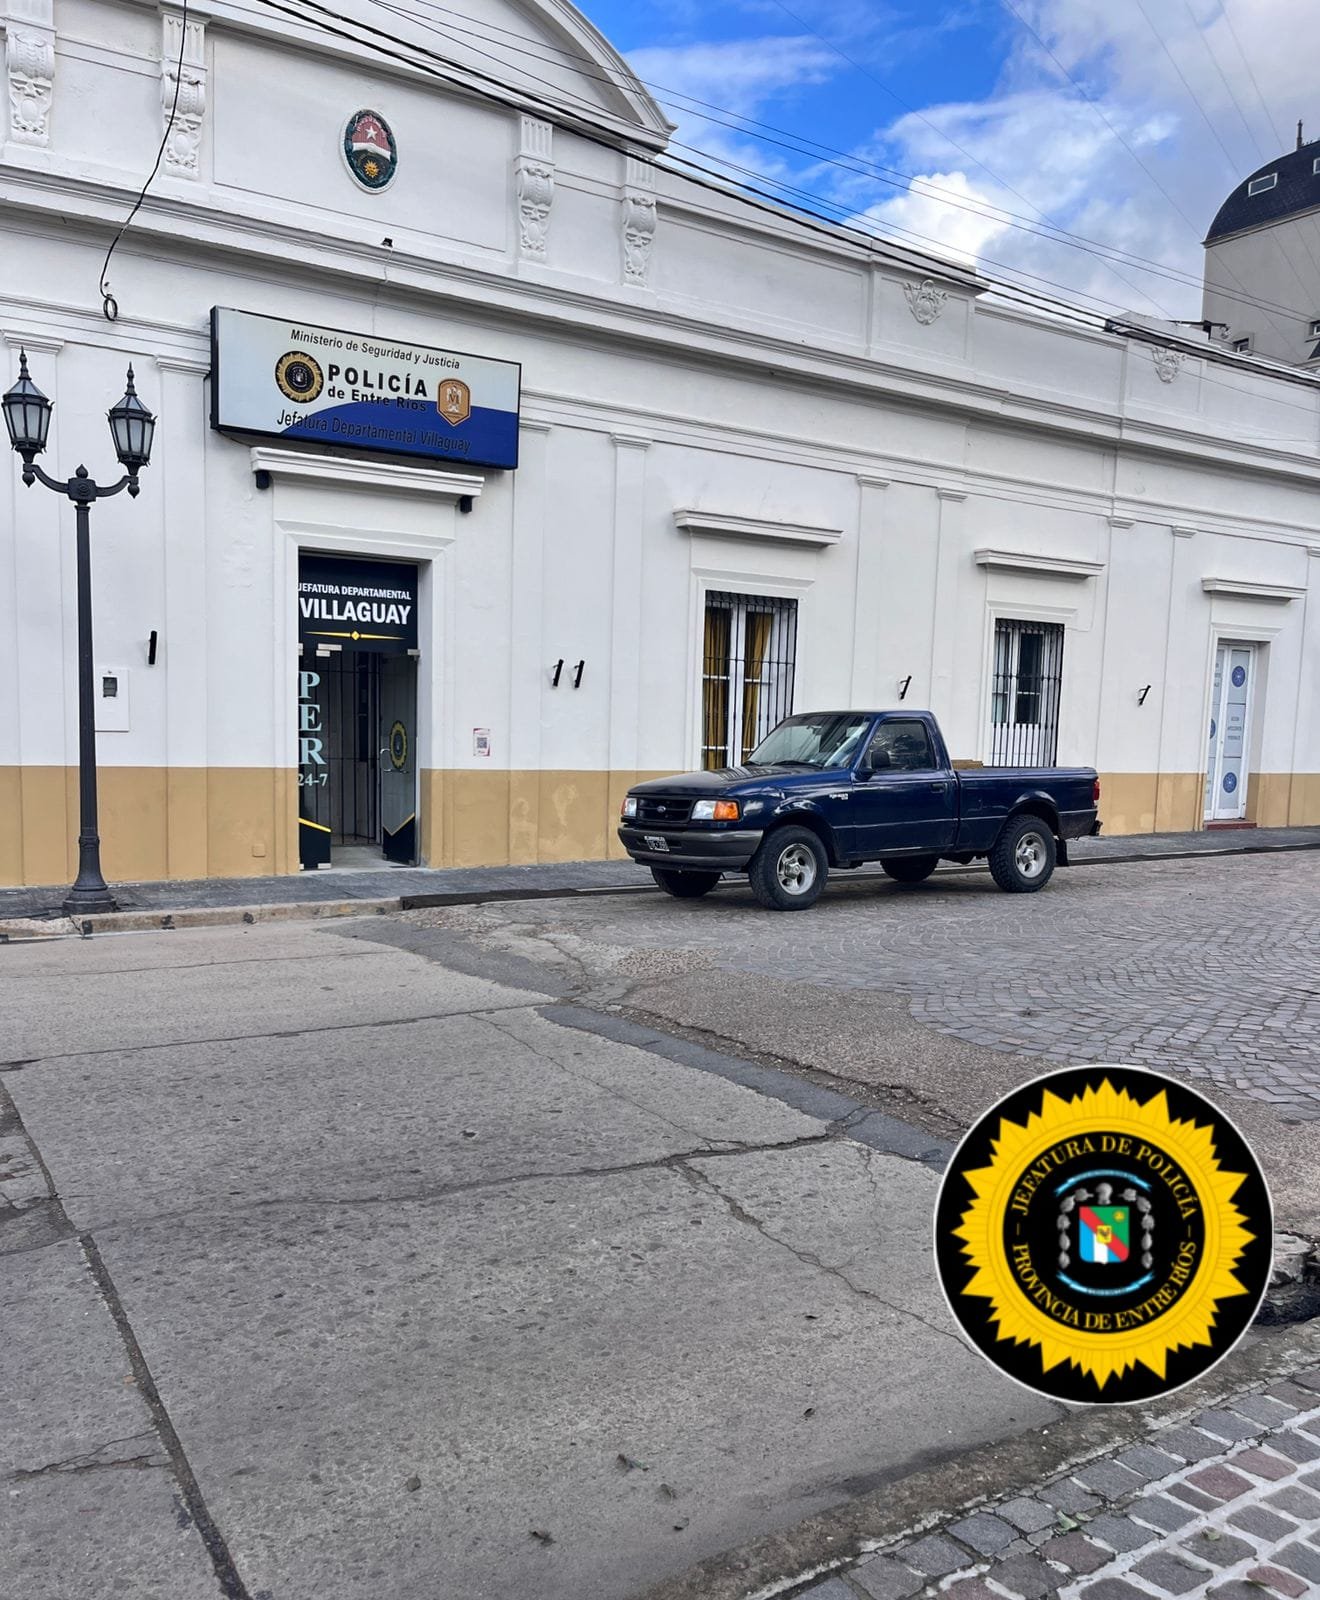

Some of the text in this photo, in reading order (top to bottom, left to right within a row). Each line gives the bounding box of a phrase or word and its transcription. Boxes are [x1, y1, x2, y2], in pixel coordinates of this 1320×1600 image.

[290, 329, 460, 370] Ministerio de Seguridad y Justicia
[328, 363, 428, 397] POLICÍA
[327, 385, 345, 399] de
[351, 388, 390, 406] Entre
[277, 409, 471, 454] Jefatura Departamental Villaguay
[298, 582, 412, 600] JEFATURA DEPARTAMENTAL
[299, 597, 411, 625] VILLAGUAY
[297, 773, 328, 786] 24-7
